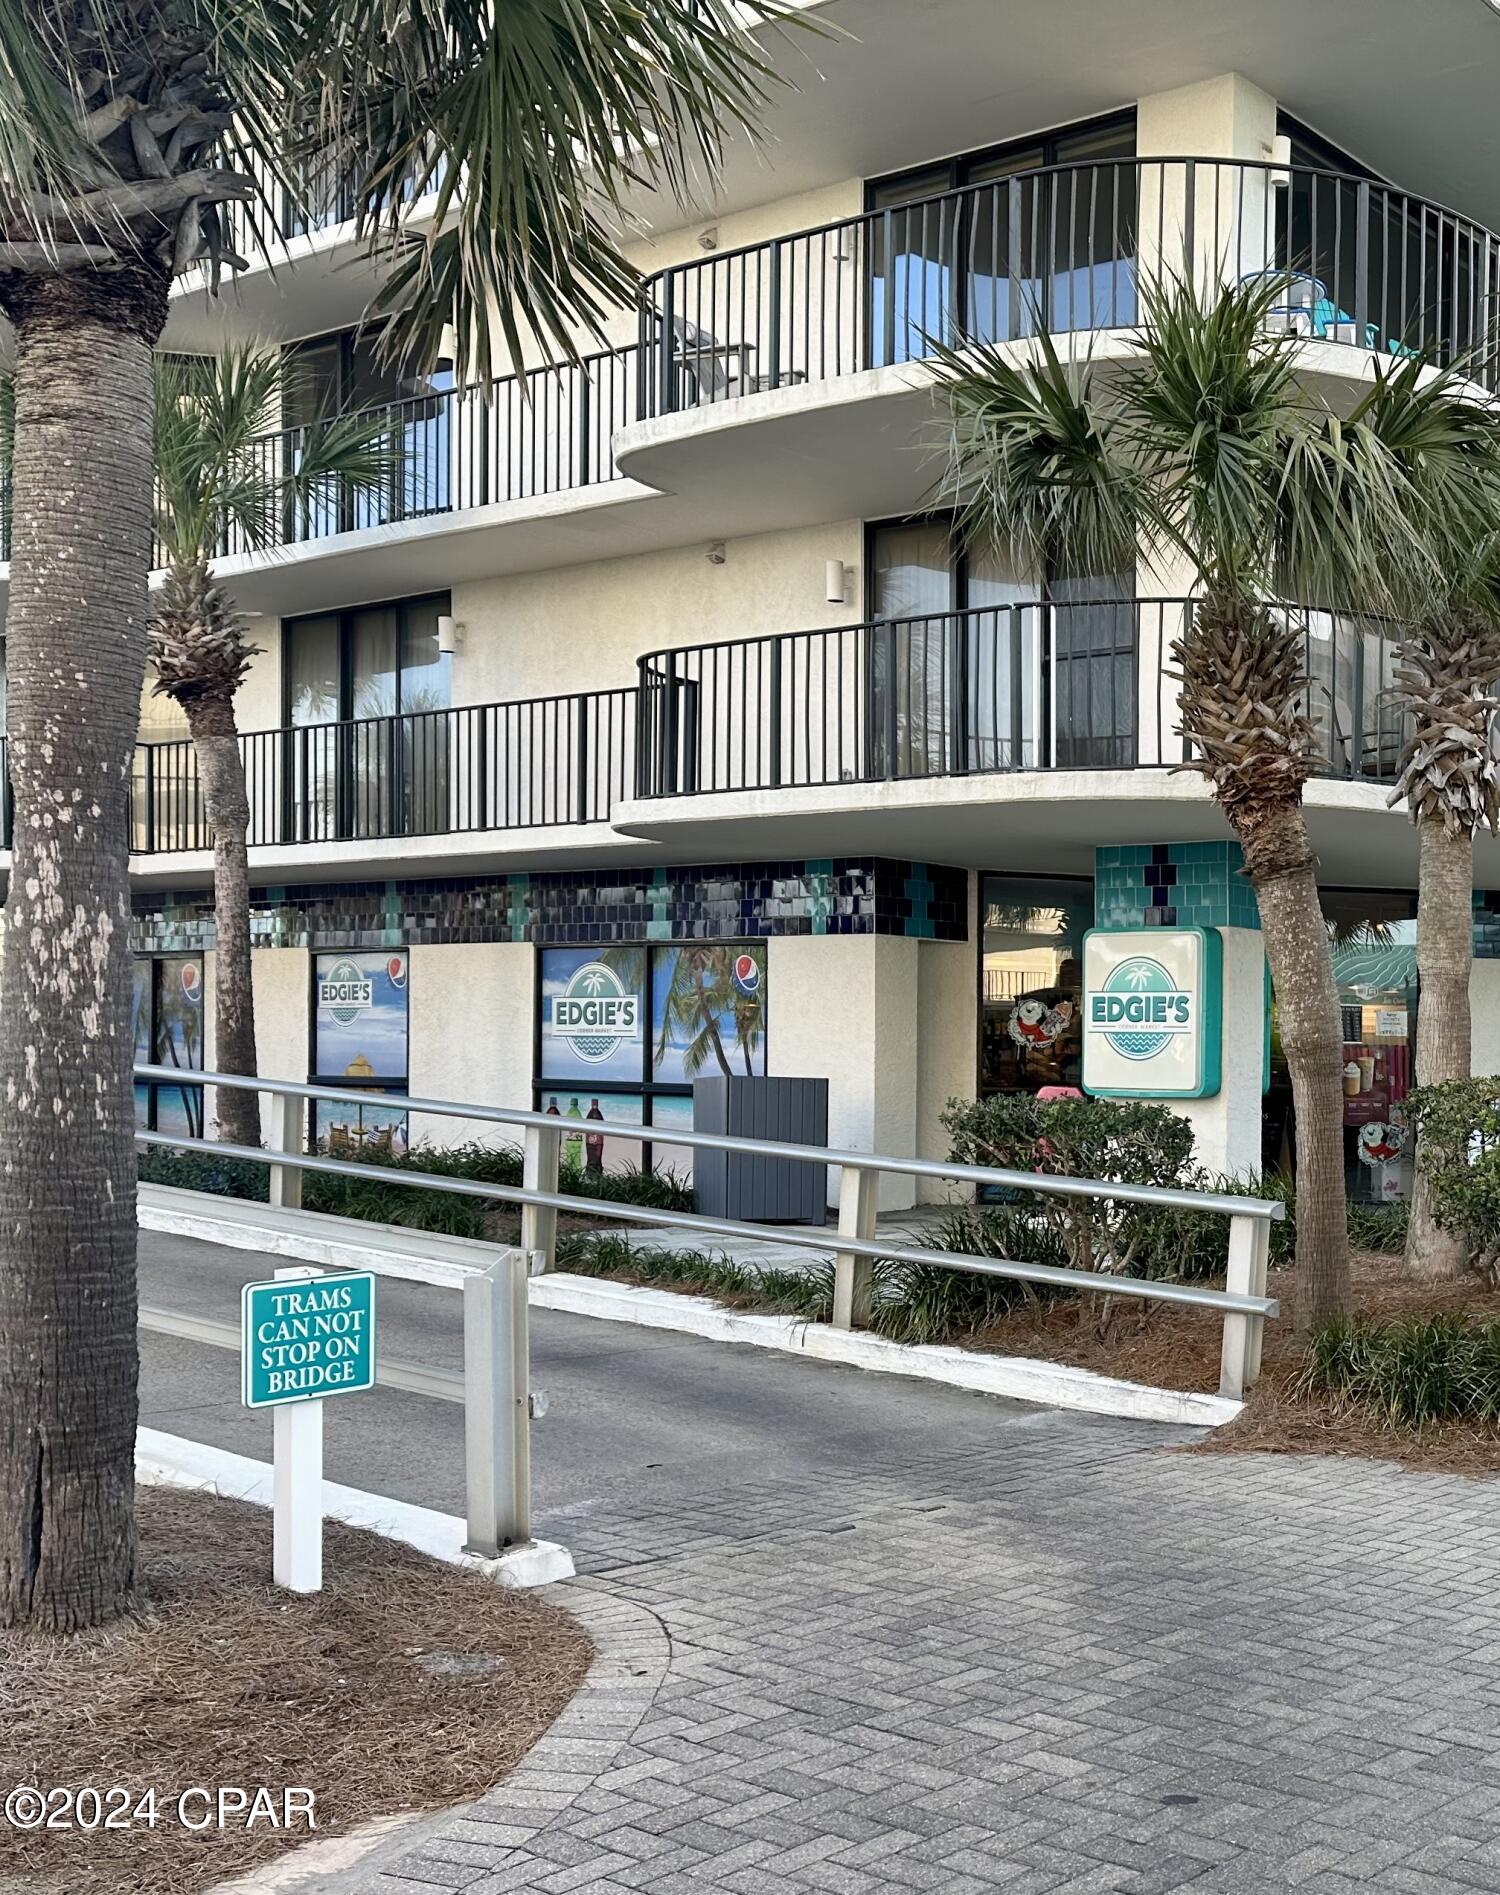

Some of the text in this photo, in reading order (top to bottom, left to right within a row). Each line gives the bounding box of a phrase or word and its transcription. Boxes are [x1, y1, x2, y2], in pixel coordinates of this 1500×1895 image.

[321, 984, 370, 1001] EDGIE'S
[556, 1001, 634, 1026] EDGIE'S
[1092, 995, 1190, 1022] EDGIE'S
[271, 1287, 352, 1316] TRAMS
[258, 1309, 365, 1343] CAN NOT
[261, 1334, 361, 1369] STOP ON
[267, 1360, 356, 1394] BRIDGE
